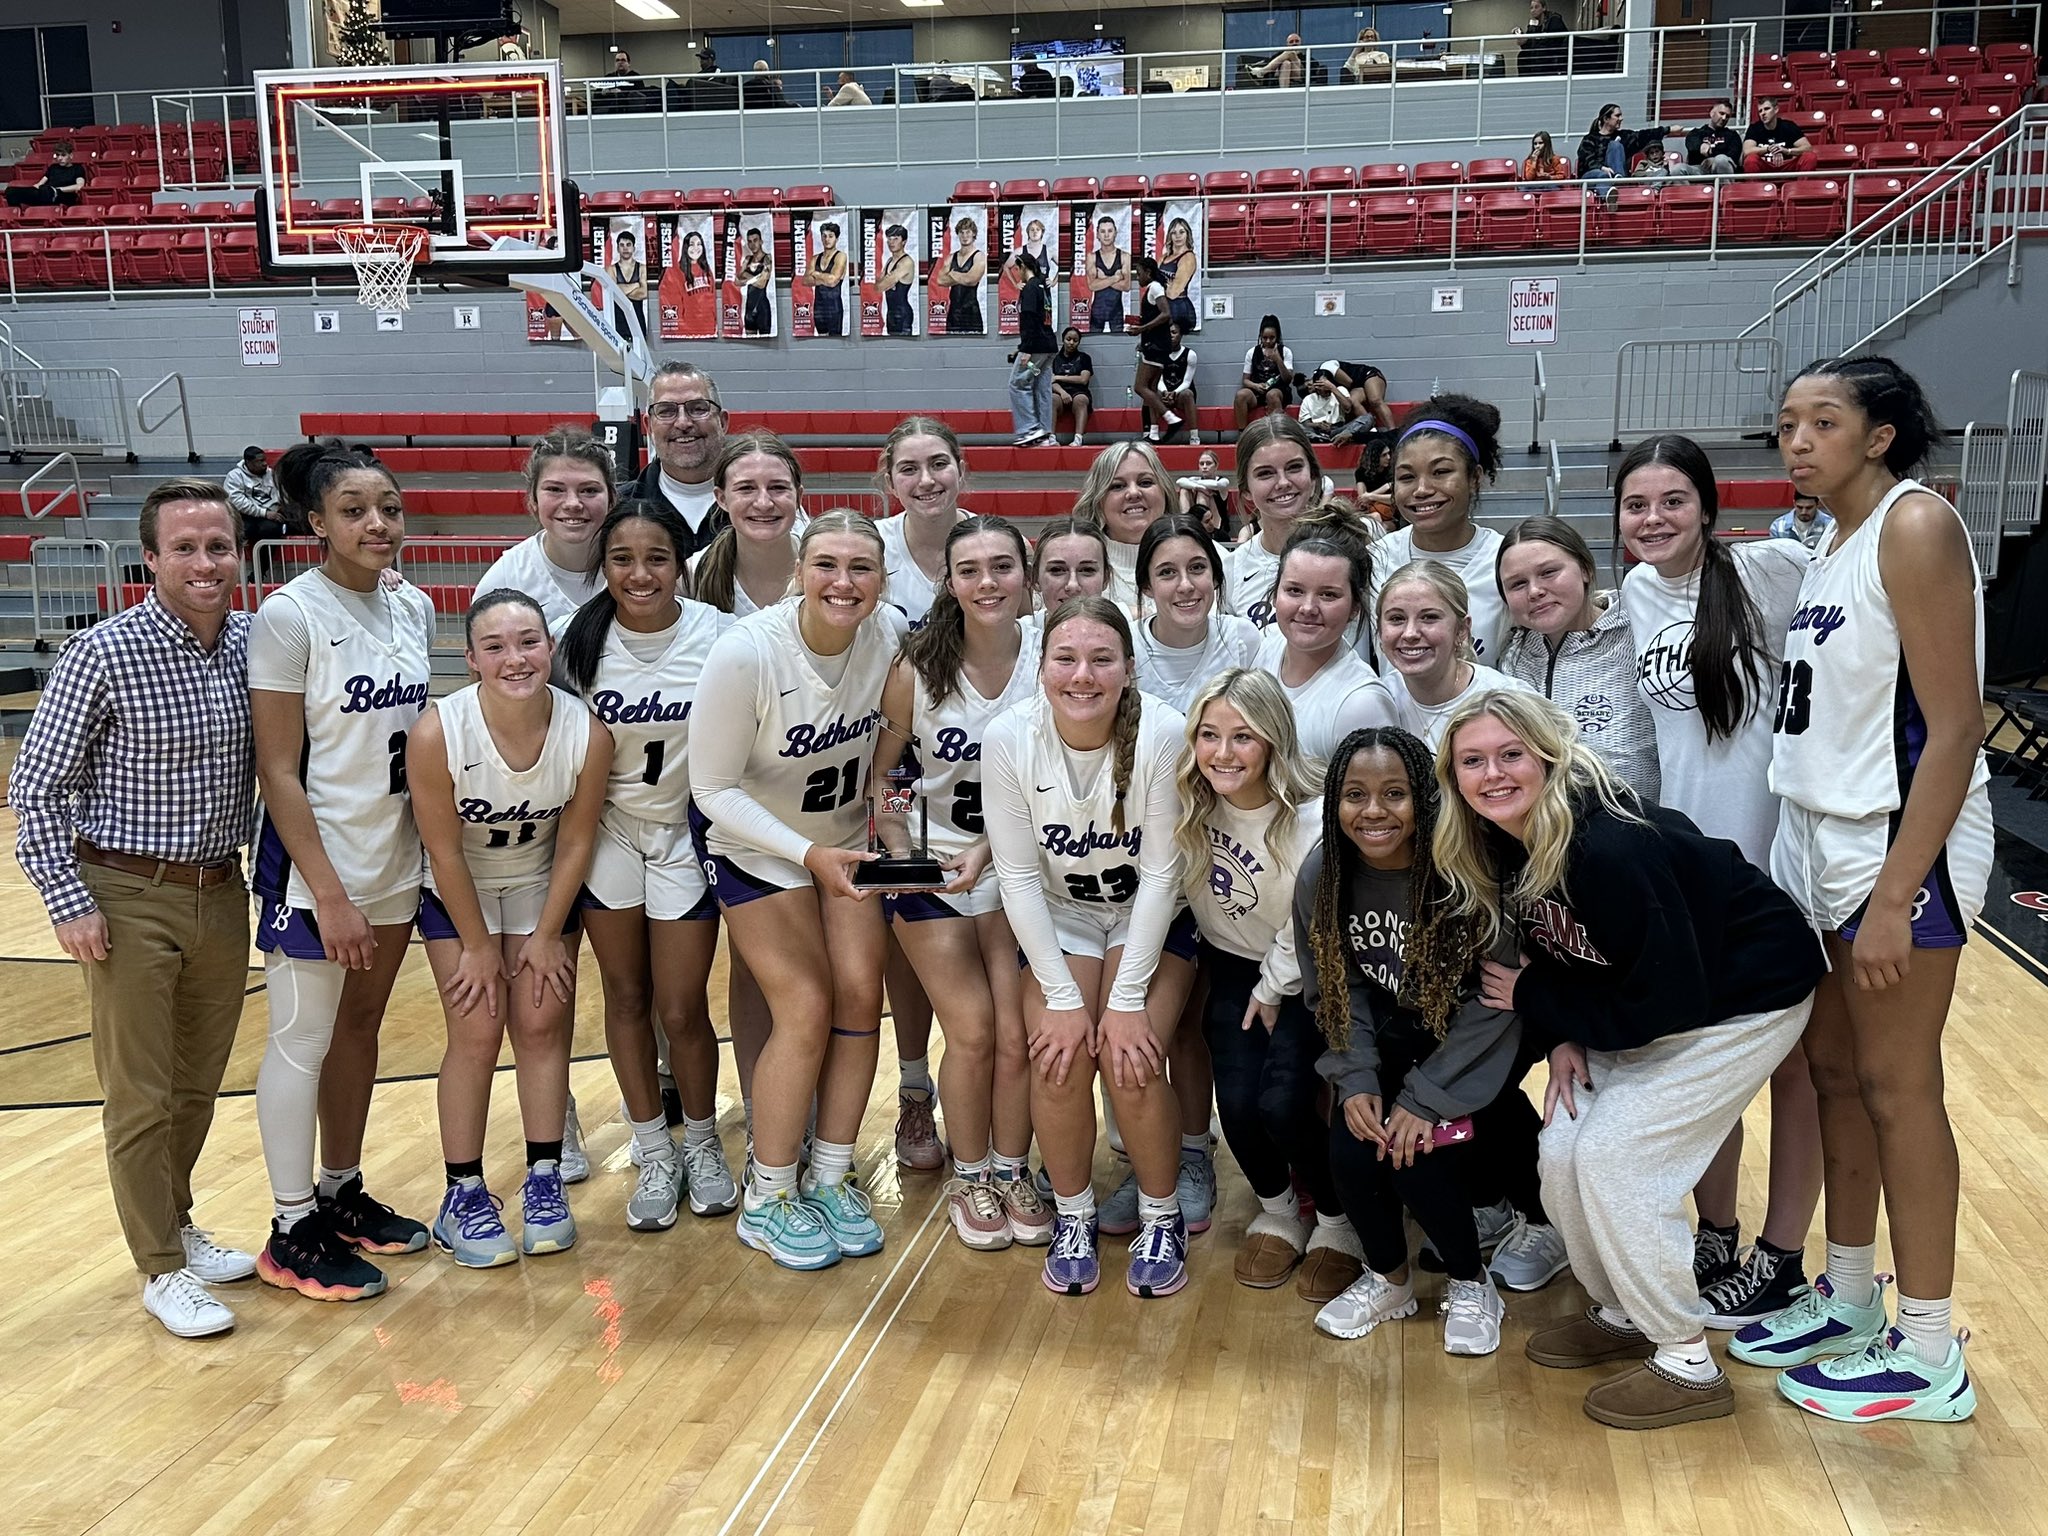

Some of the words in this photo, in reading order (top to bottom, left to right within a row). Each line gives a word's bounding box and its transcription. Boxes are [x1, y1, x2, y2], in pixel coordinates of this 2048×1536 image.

[594, 230, 605, 268] ILLER
[661, 228, 673, 267] REYES
[725, 227, 737, 281] DOUGLAS
[864, 223, 876, 283] ROBINSON
[932, 221, 943, 258] PRITZ
[1003, 220, 1014, 253] LOVE
[1074, 218, 1086, 276] SPRAGUE
[1144, 216, 1157, 258] EYMAN
[1513, 292, 1555, 308] STUDENT
[242, 320, 275, 335] STUDENT
[600, 322, 619, 348] Sports
[1513, 315, 1553, 331] SECTION
[244, 340, 276, 355] SECTION
[1773, 659, 1813, 735] 33
[642, 740, 664, 786] 1
[801, 756, 861, 813] 21
[458, 796, 569, 824] Bethan
[485, 822, 537, 848] 11
[703, 859, 718, 886] B
[1063, 863, 1140, 904] 23
[270, 903, 293, 931] B
[1360, 964, 1398, 994] RON
